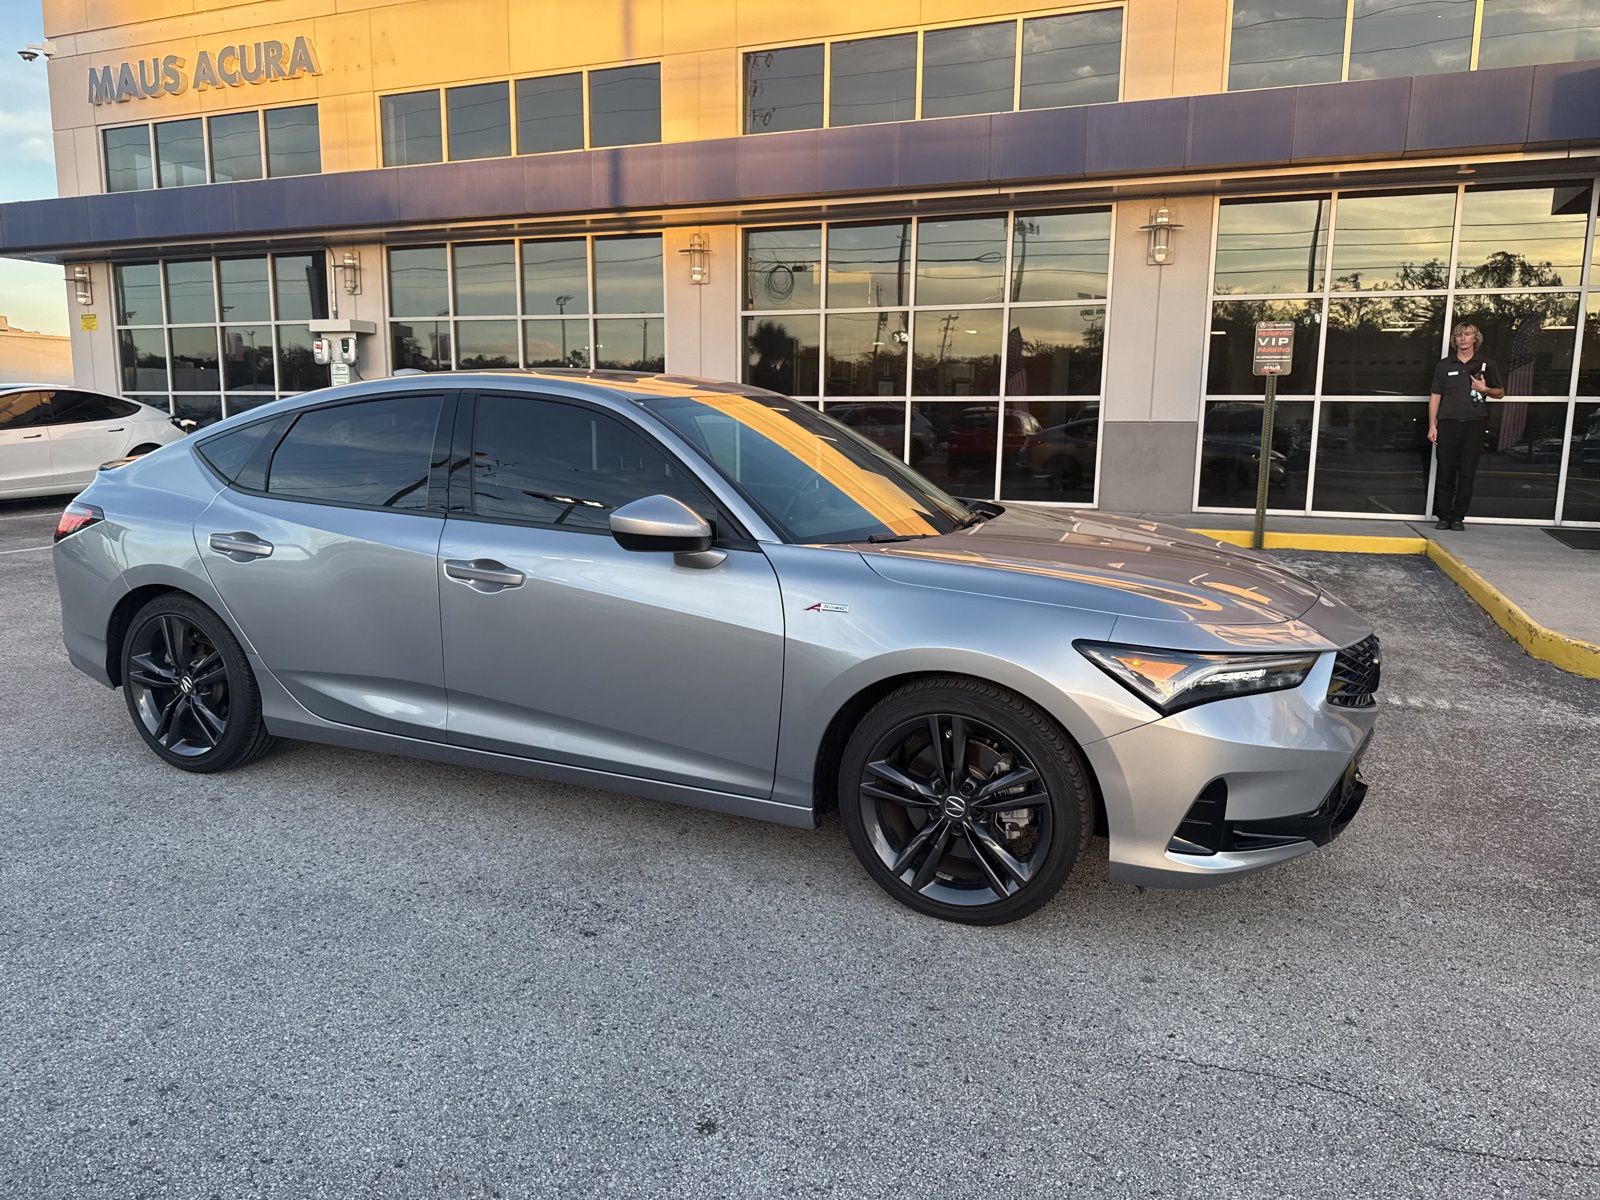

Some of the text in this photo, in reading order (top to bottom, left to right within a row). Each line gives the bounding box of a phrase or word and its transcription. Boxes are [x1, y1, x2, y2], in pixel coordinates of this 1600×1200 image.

[88, 36, 323, 106] MAUS ACURA
[1258, 337, 1289, 346] VIP
